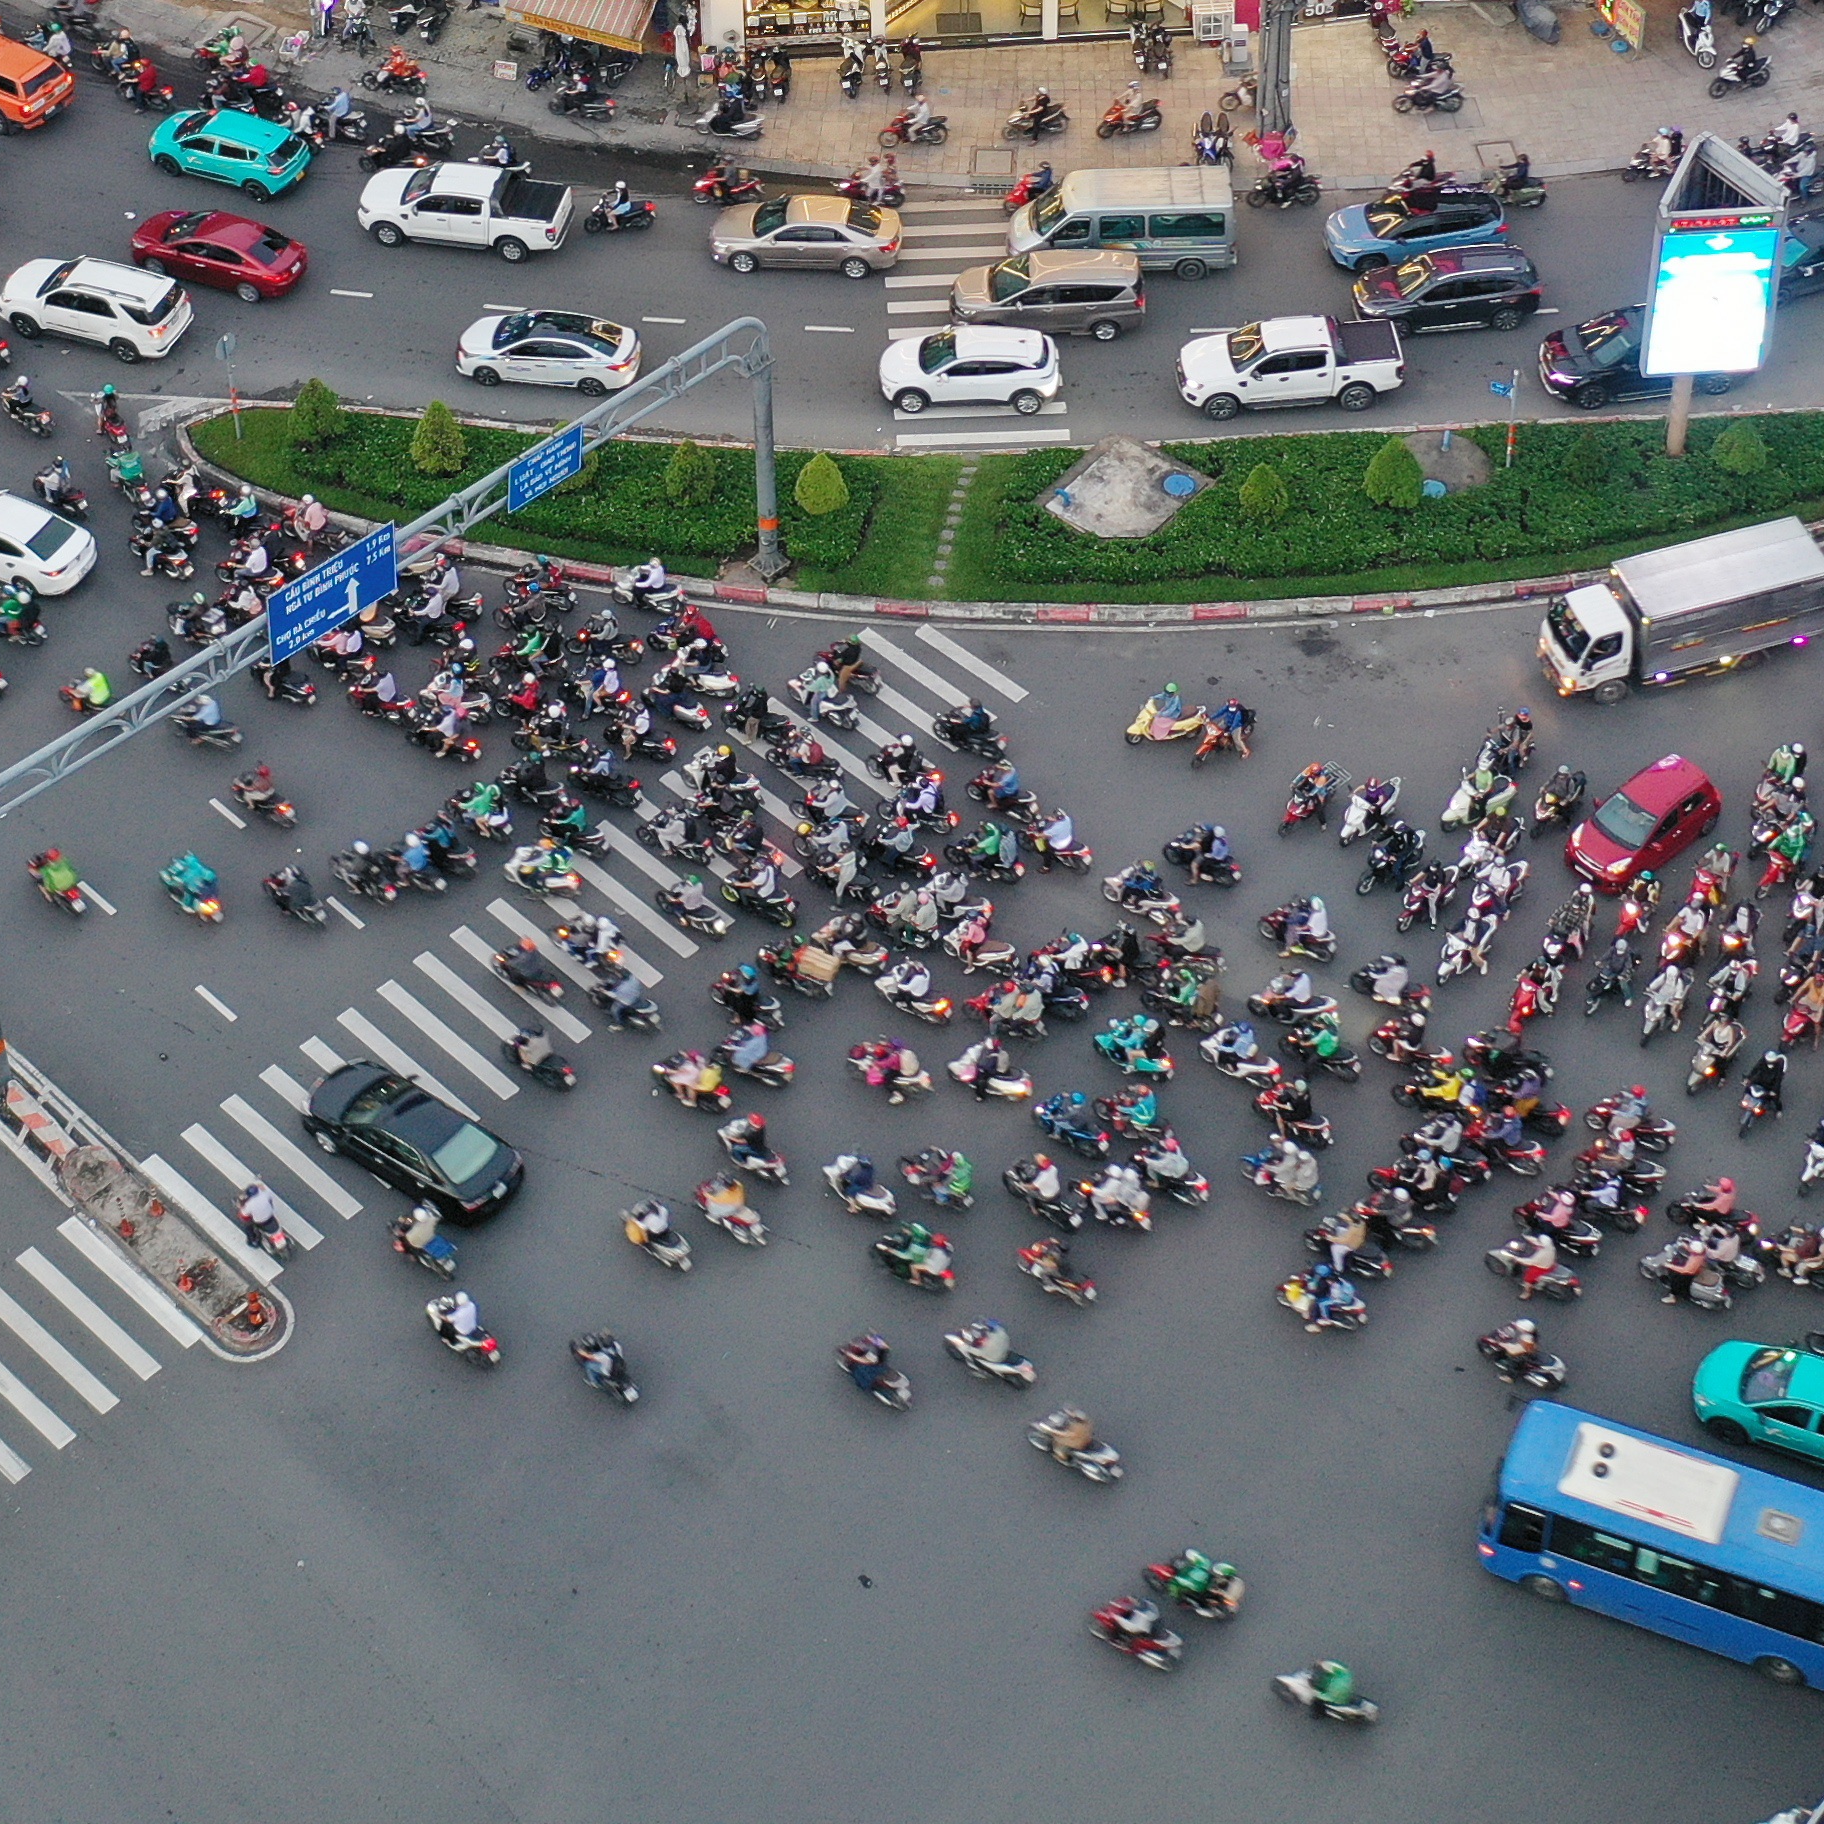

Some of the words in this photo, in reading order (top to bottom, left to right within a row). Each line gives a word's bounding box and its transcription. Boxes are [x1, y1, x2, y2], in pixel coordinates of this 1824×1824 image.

[366, 540, 377, 553] 1.9
[366, 552, 378, 566] 7.5
[334, 562, 360, 585] PHƯỚC
[285, 586, 301, 603] CẦU
[288, 635, 301, 650] 2.0
